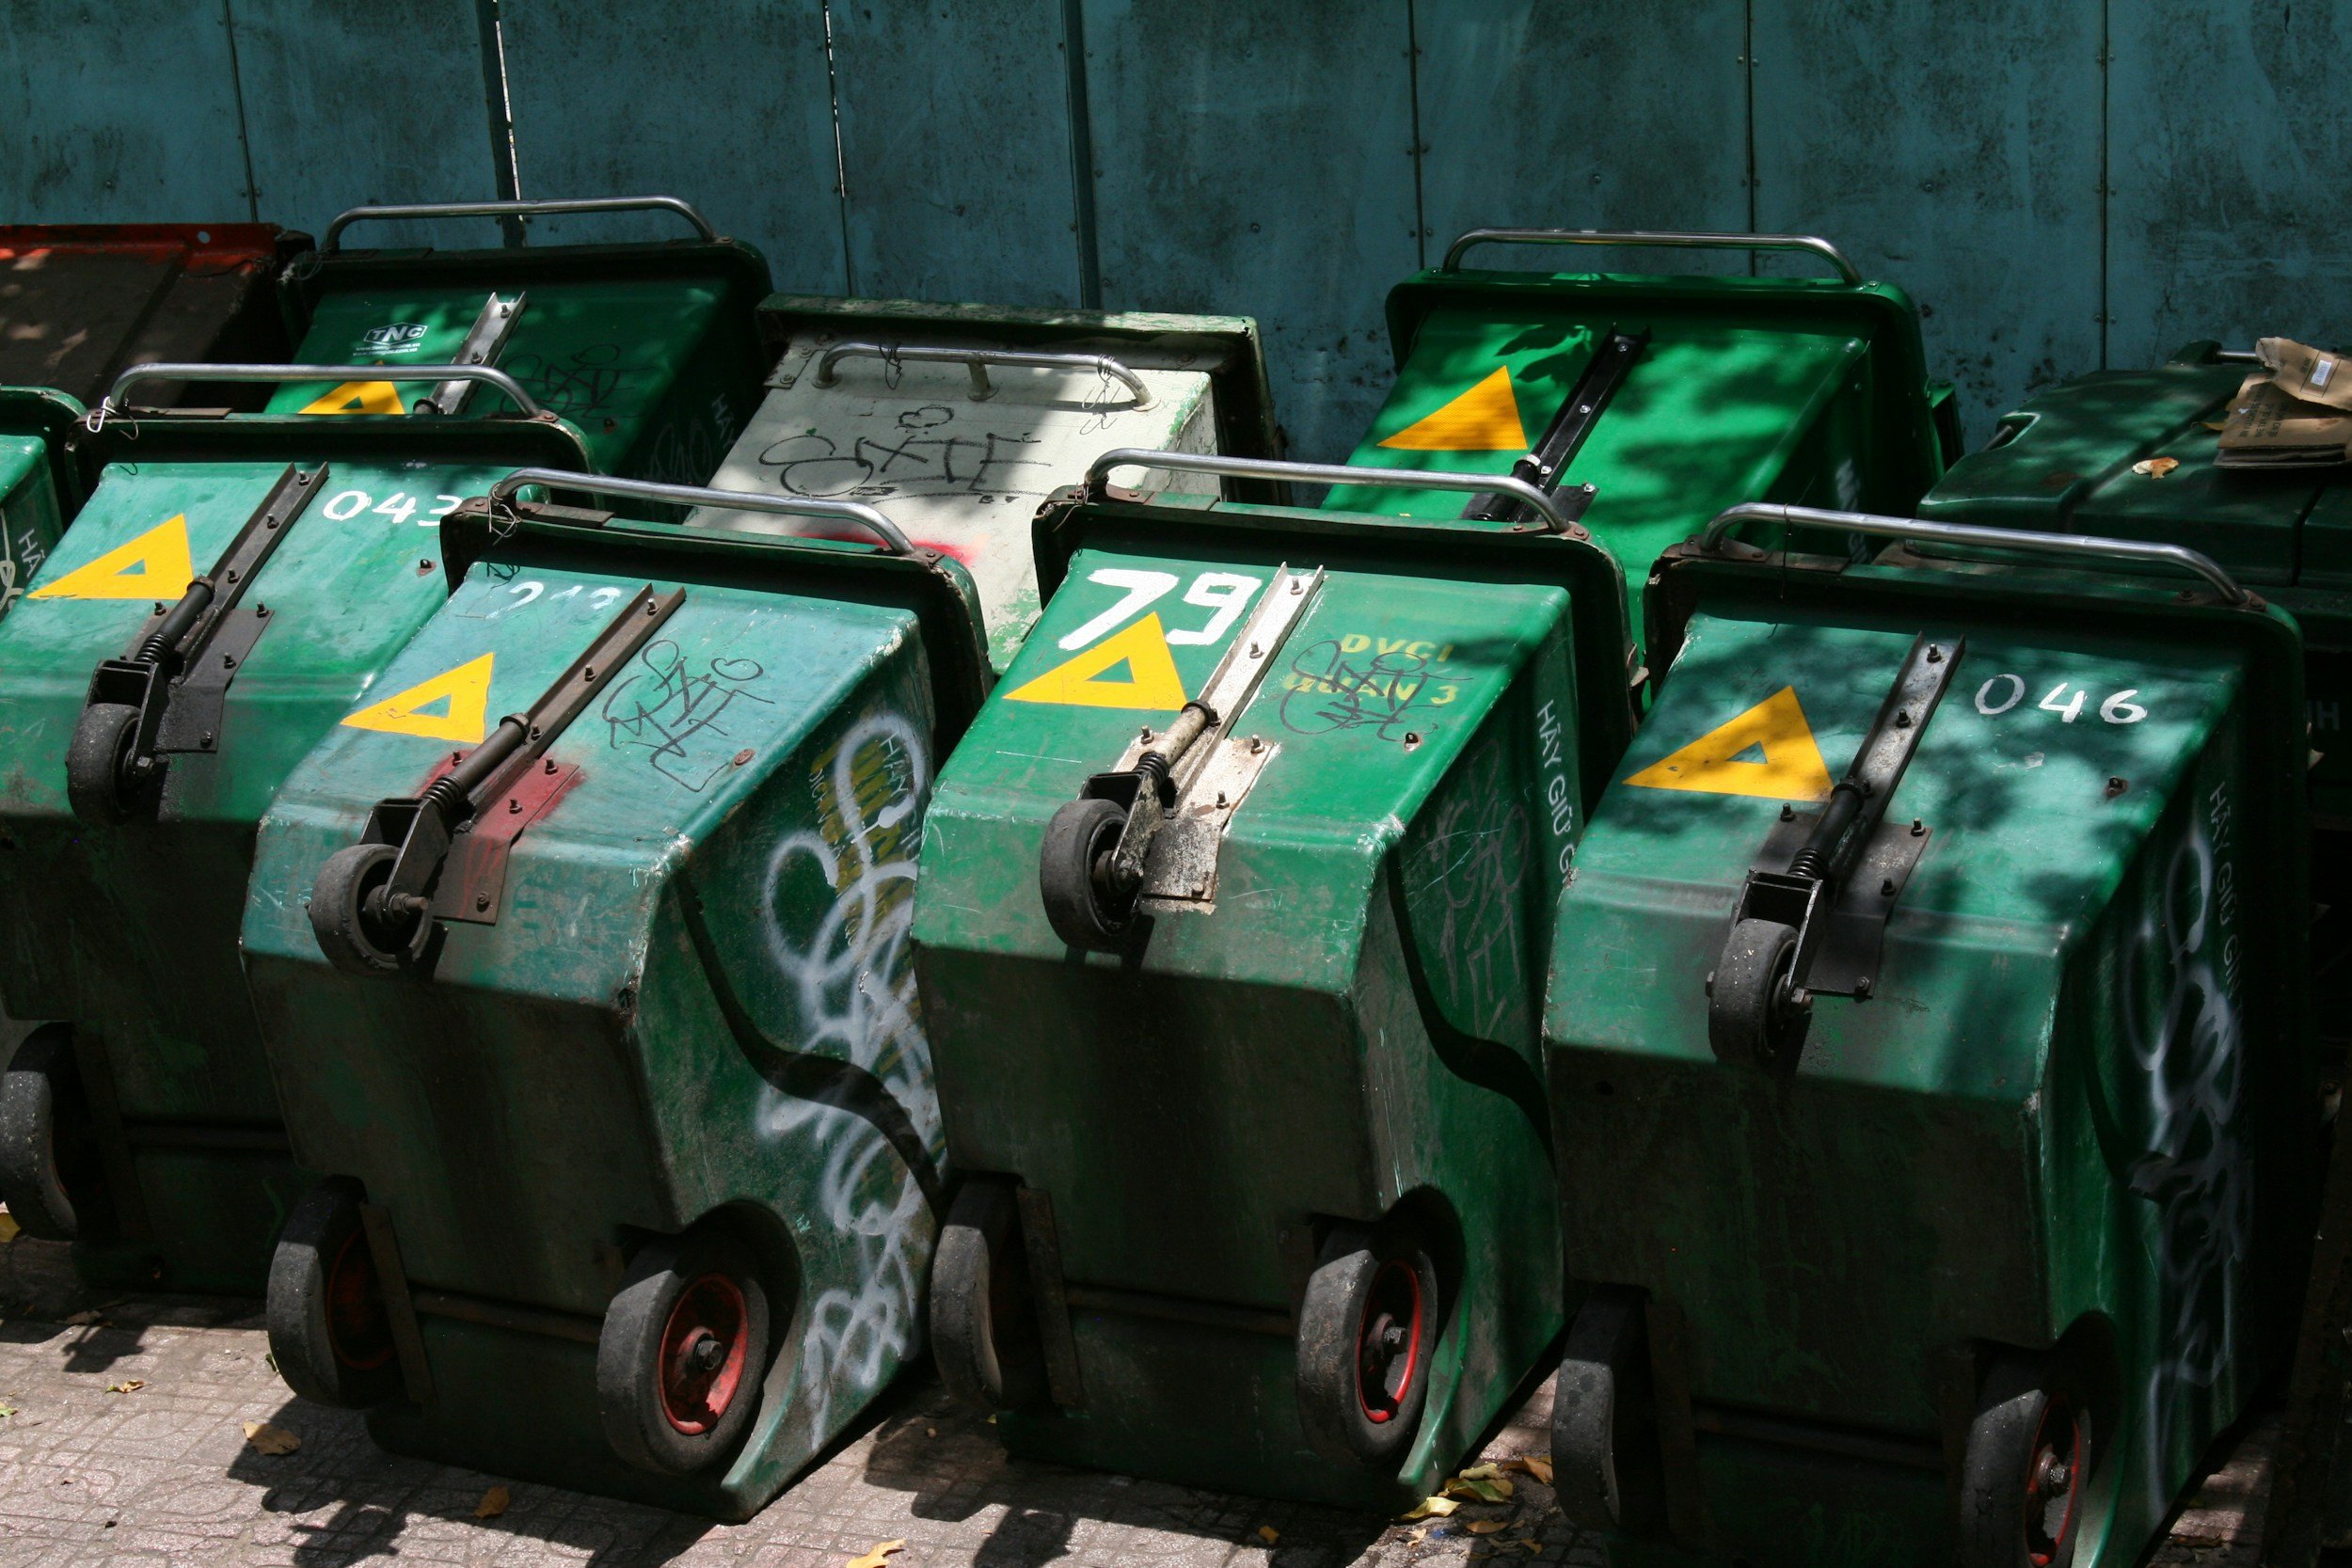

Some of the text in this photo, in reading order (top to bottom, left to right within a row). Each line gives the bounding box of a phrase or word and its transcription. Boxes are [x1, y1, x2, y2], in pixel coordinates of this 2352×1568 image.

[372, 325, 423, 342] TNC
[323, 490, 464, 527] 043
[18, 528, 46, 579] HÃ
[1057, 567, 1263, 651] 79
[1431, 685, 1461, 705] 3
[1975, 673, 2148, 724] 046
[1536, 698, 1563, 768] HÃY
